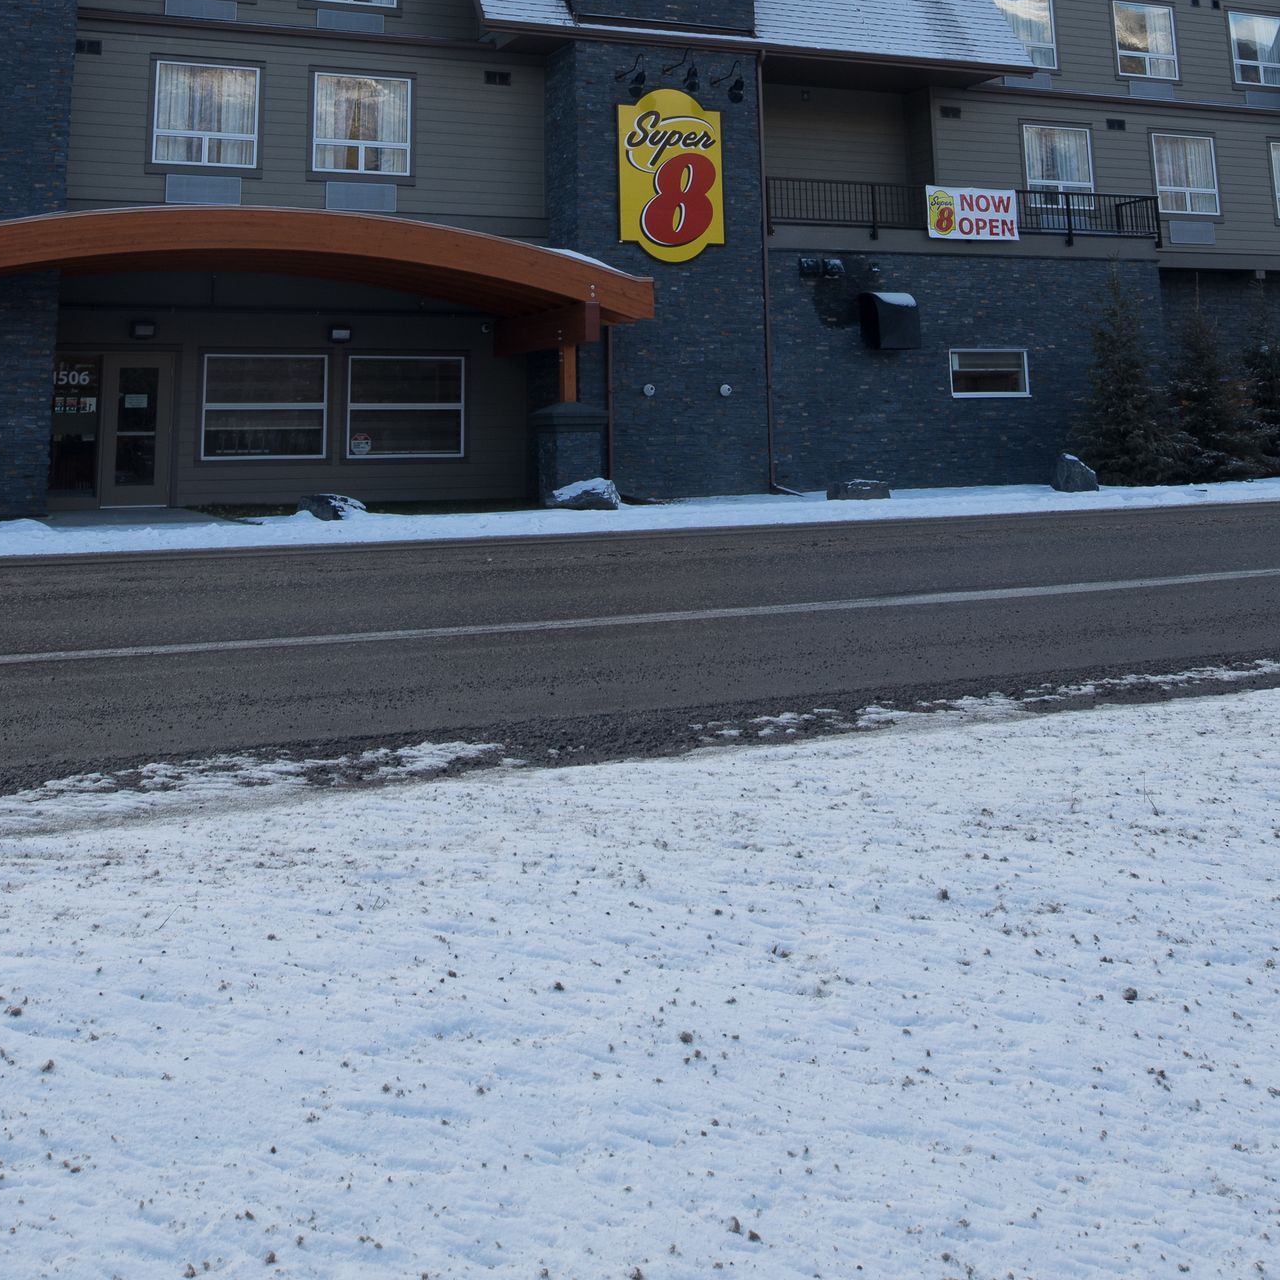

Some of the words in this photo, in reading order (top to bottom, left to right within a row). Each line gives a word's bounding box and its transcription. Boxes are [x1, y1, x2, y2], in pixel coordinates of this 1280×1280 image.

[626, 110, 716, 168] Super
[640, 153, 716, 247] 8
[930, 195, 953, 211] Super
[959, 194, 1011, 213] NOW
[935, 207, 954, 232] 8
[959, 217, 1015, 237] OPEN
